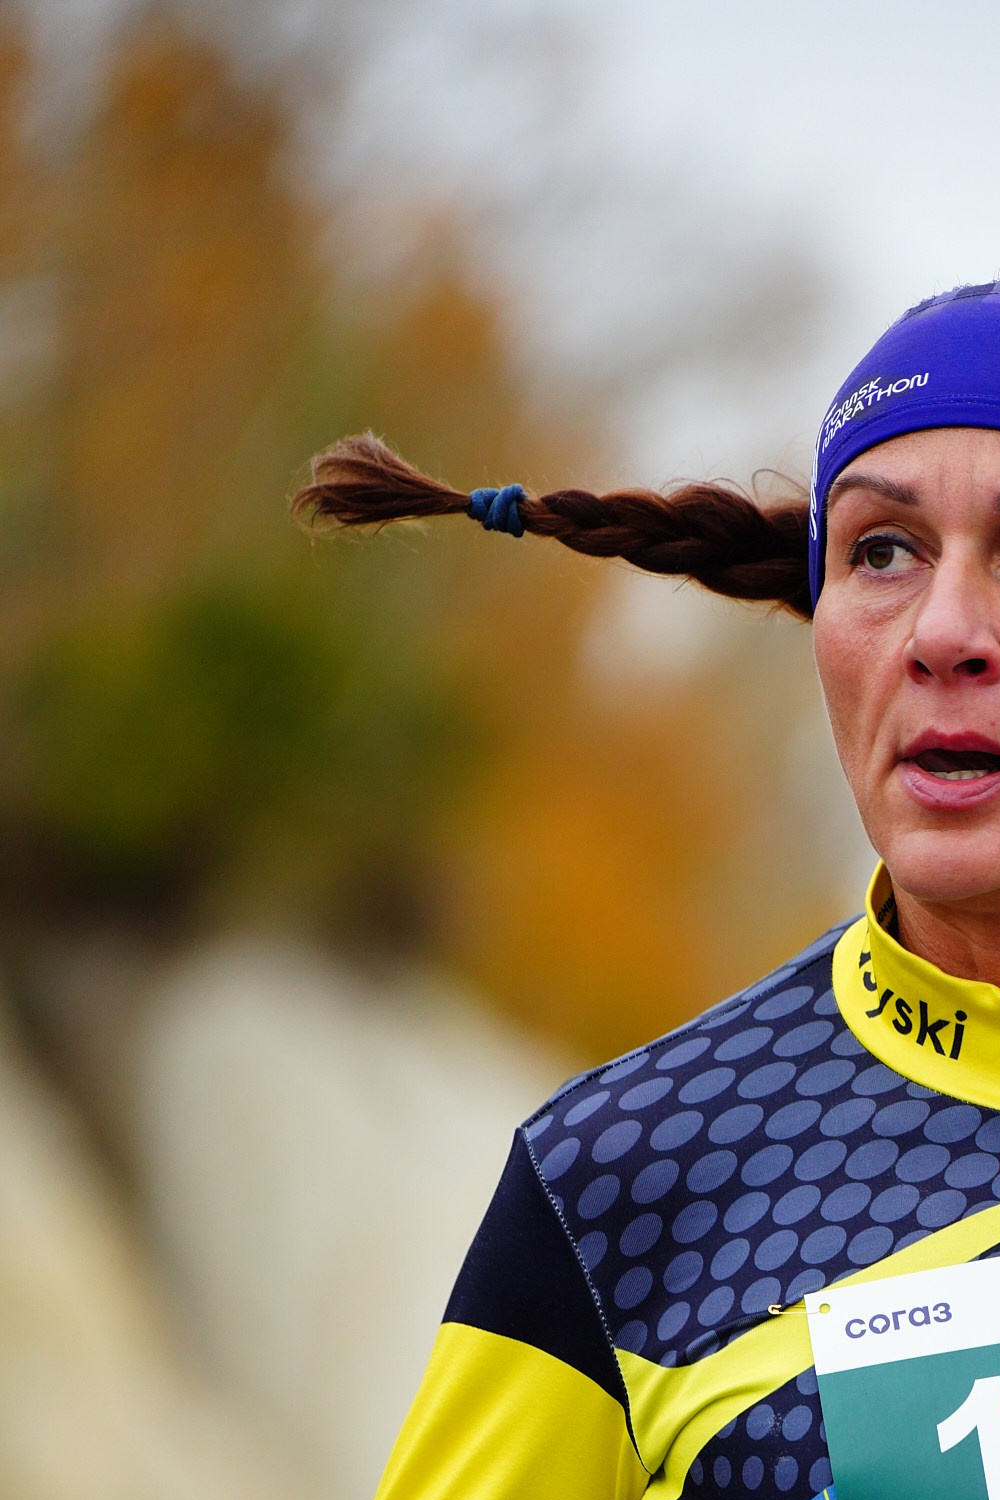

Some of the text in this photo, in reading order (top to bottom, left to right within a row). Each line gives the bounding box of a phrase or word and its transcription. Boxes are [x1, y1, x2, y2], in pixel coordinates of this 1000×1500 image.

[822, 372, 929, 454] MARATHON
[825, 376, 882, 435] TOMSK
[845, 1302, 952, 1339] согаз
